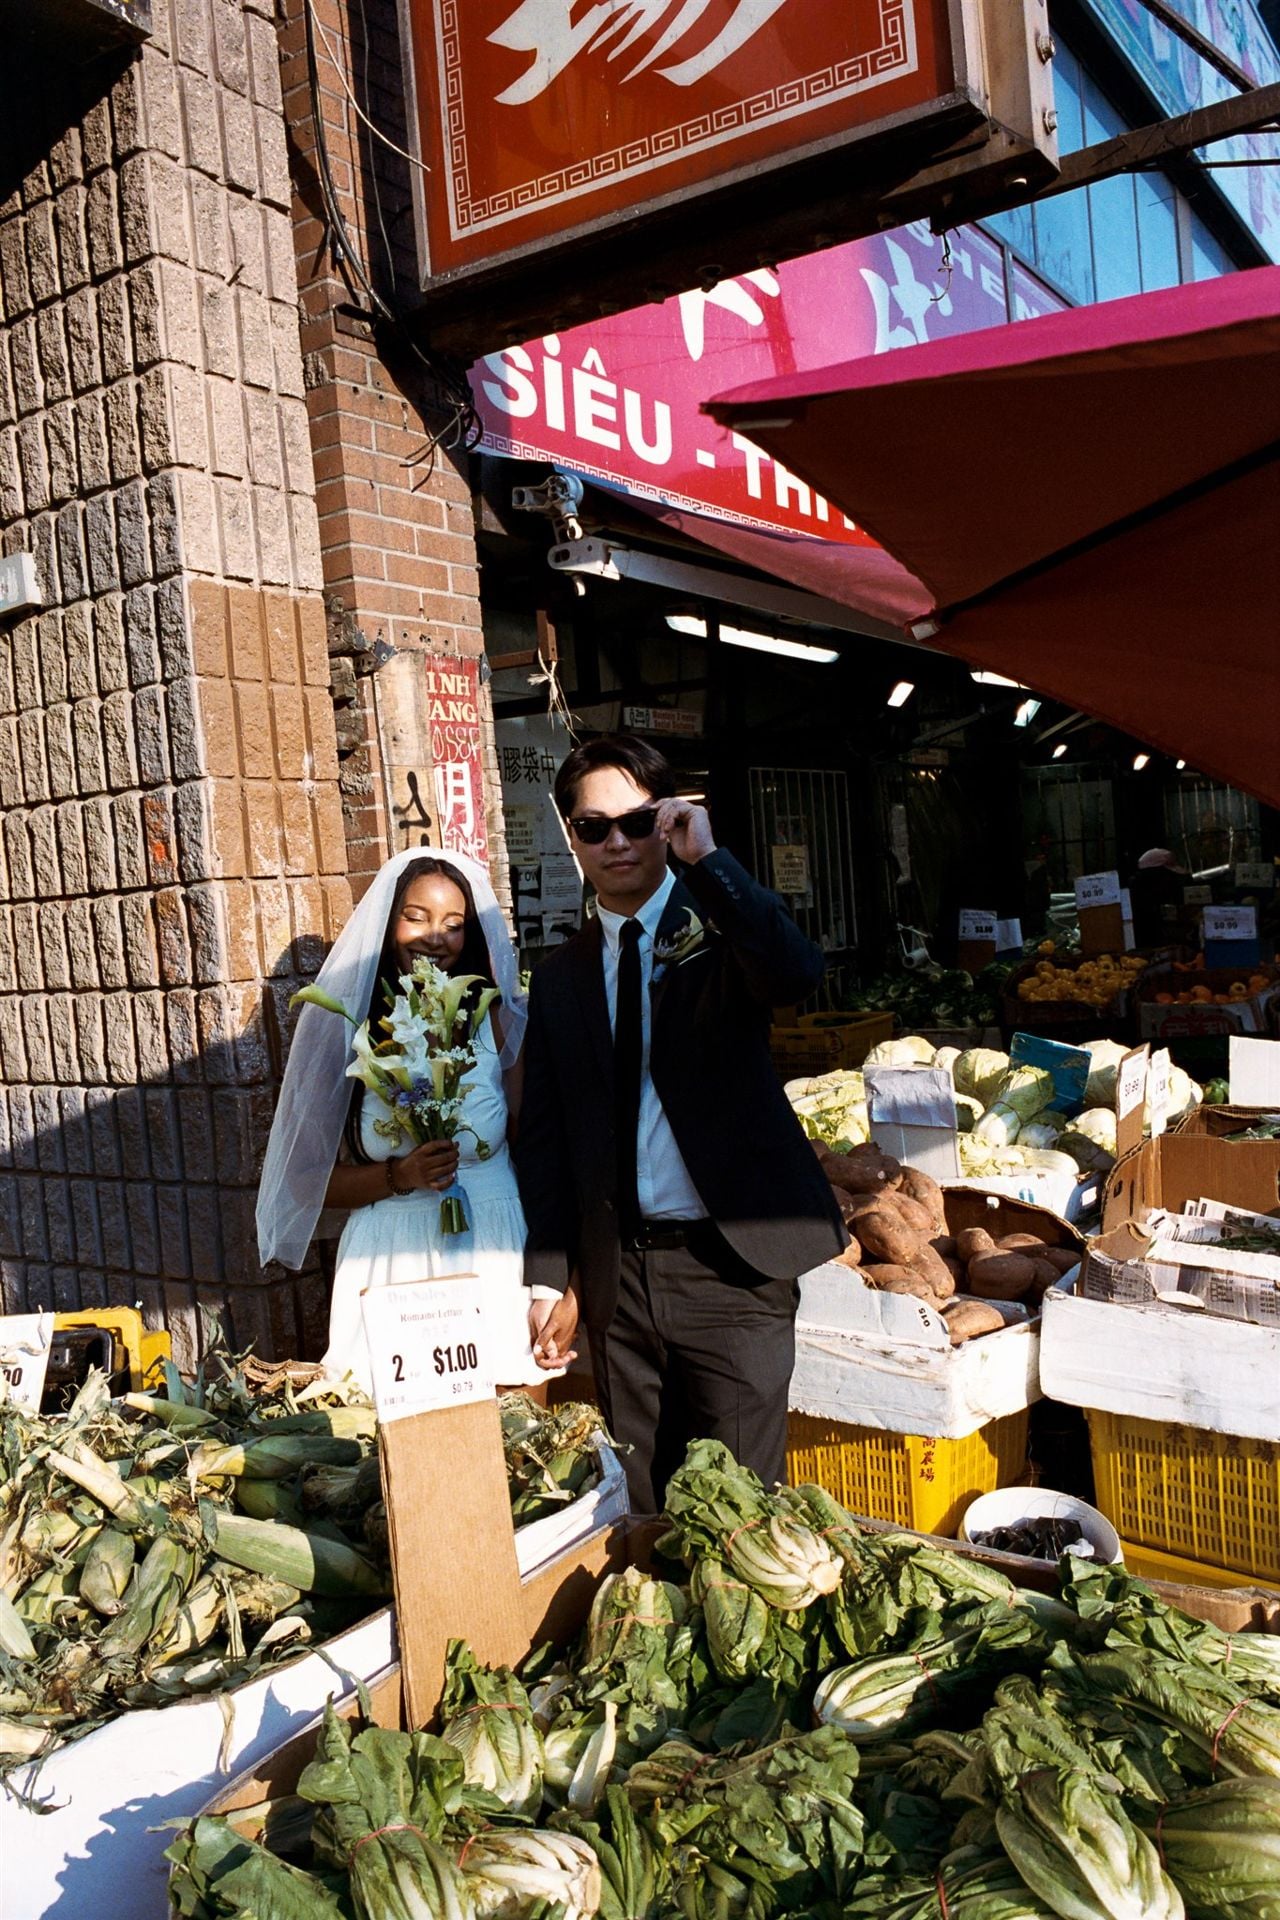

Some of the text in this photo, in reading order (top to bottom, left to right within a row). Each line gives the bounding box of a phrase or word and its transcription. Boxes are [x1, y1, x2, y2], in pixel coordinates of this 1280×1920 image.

[496, 746, 556, 784] 膠袋中
[392, 1354, 405, 1382] 2
[432, 1342, 478, 1377] $1.00
[452, 1381, 474, 1394] $0.79
